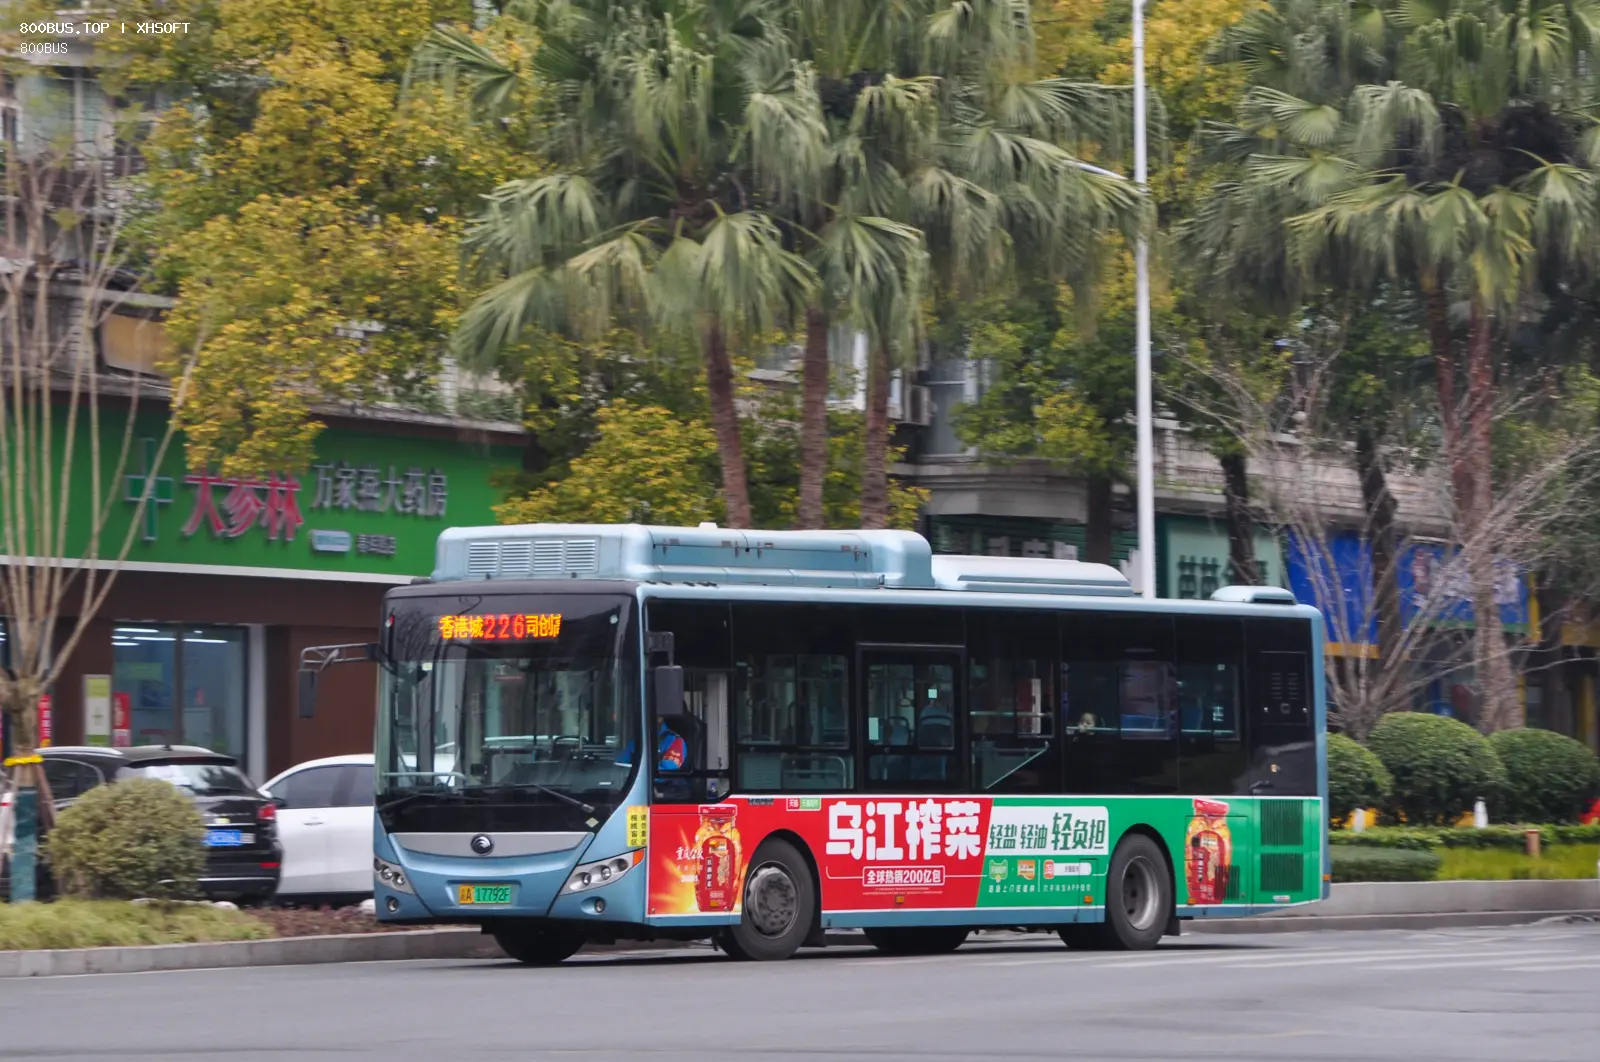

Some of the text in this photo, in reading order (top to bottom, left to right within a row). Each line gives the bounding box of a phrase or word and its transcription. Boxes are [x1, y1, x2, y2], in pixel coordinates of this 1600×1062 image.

[439, 615, 483, 639] 香港城
[483, 613, 525, 639] 226
[825, 798, 981, 861] 乌江榨菜
[989, 811, 1106, 851] 轻盐 轻油 轻负担
[866, 869, 941, 884] 全球热销200亿包
